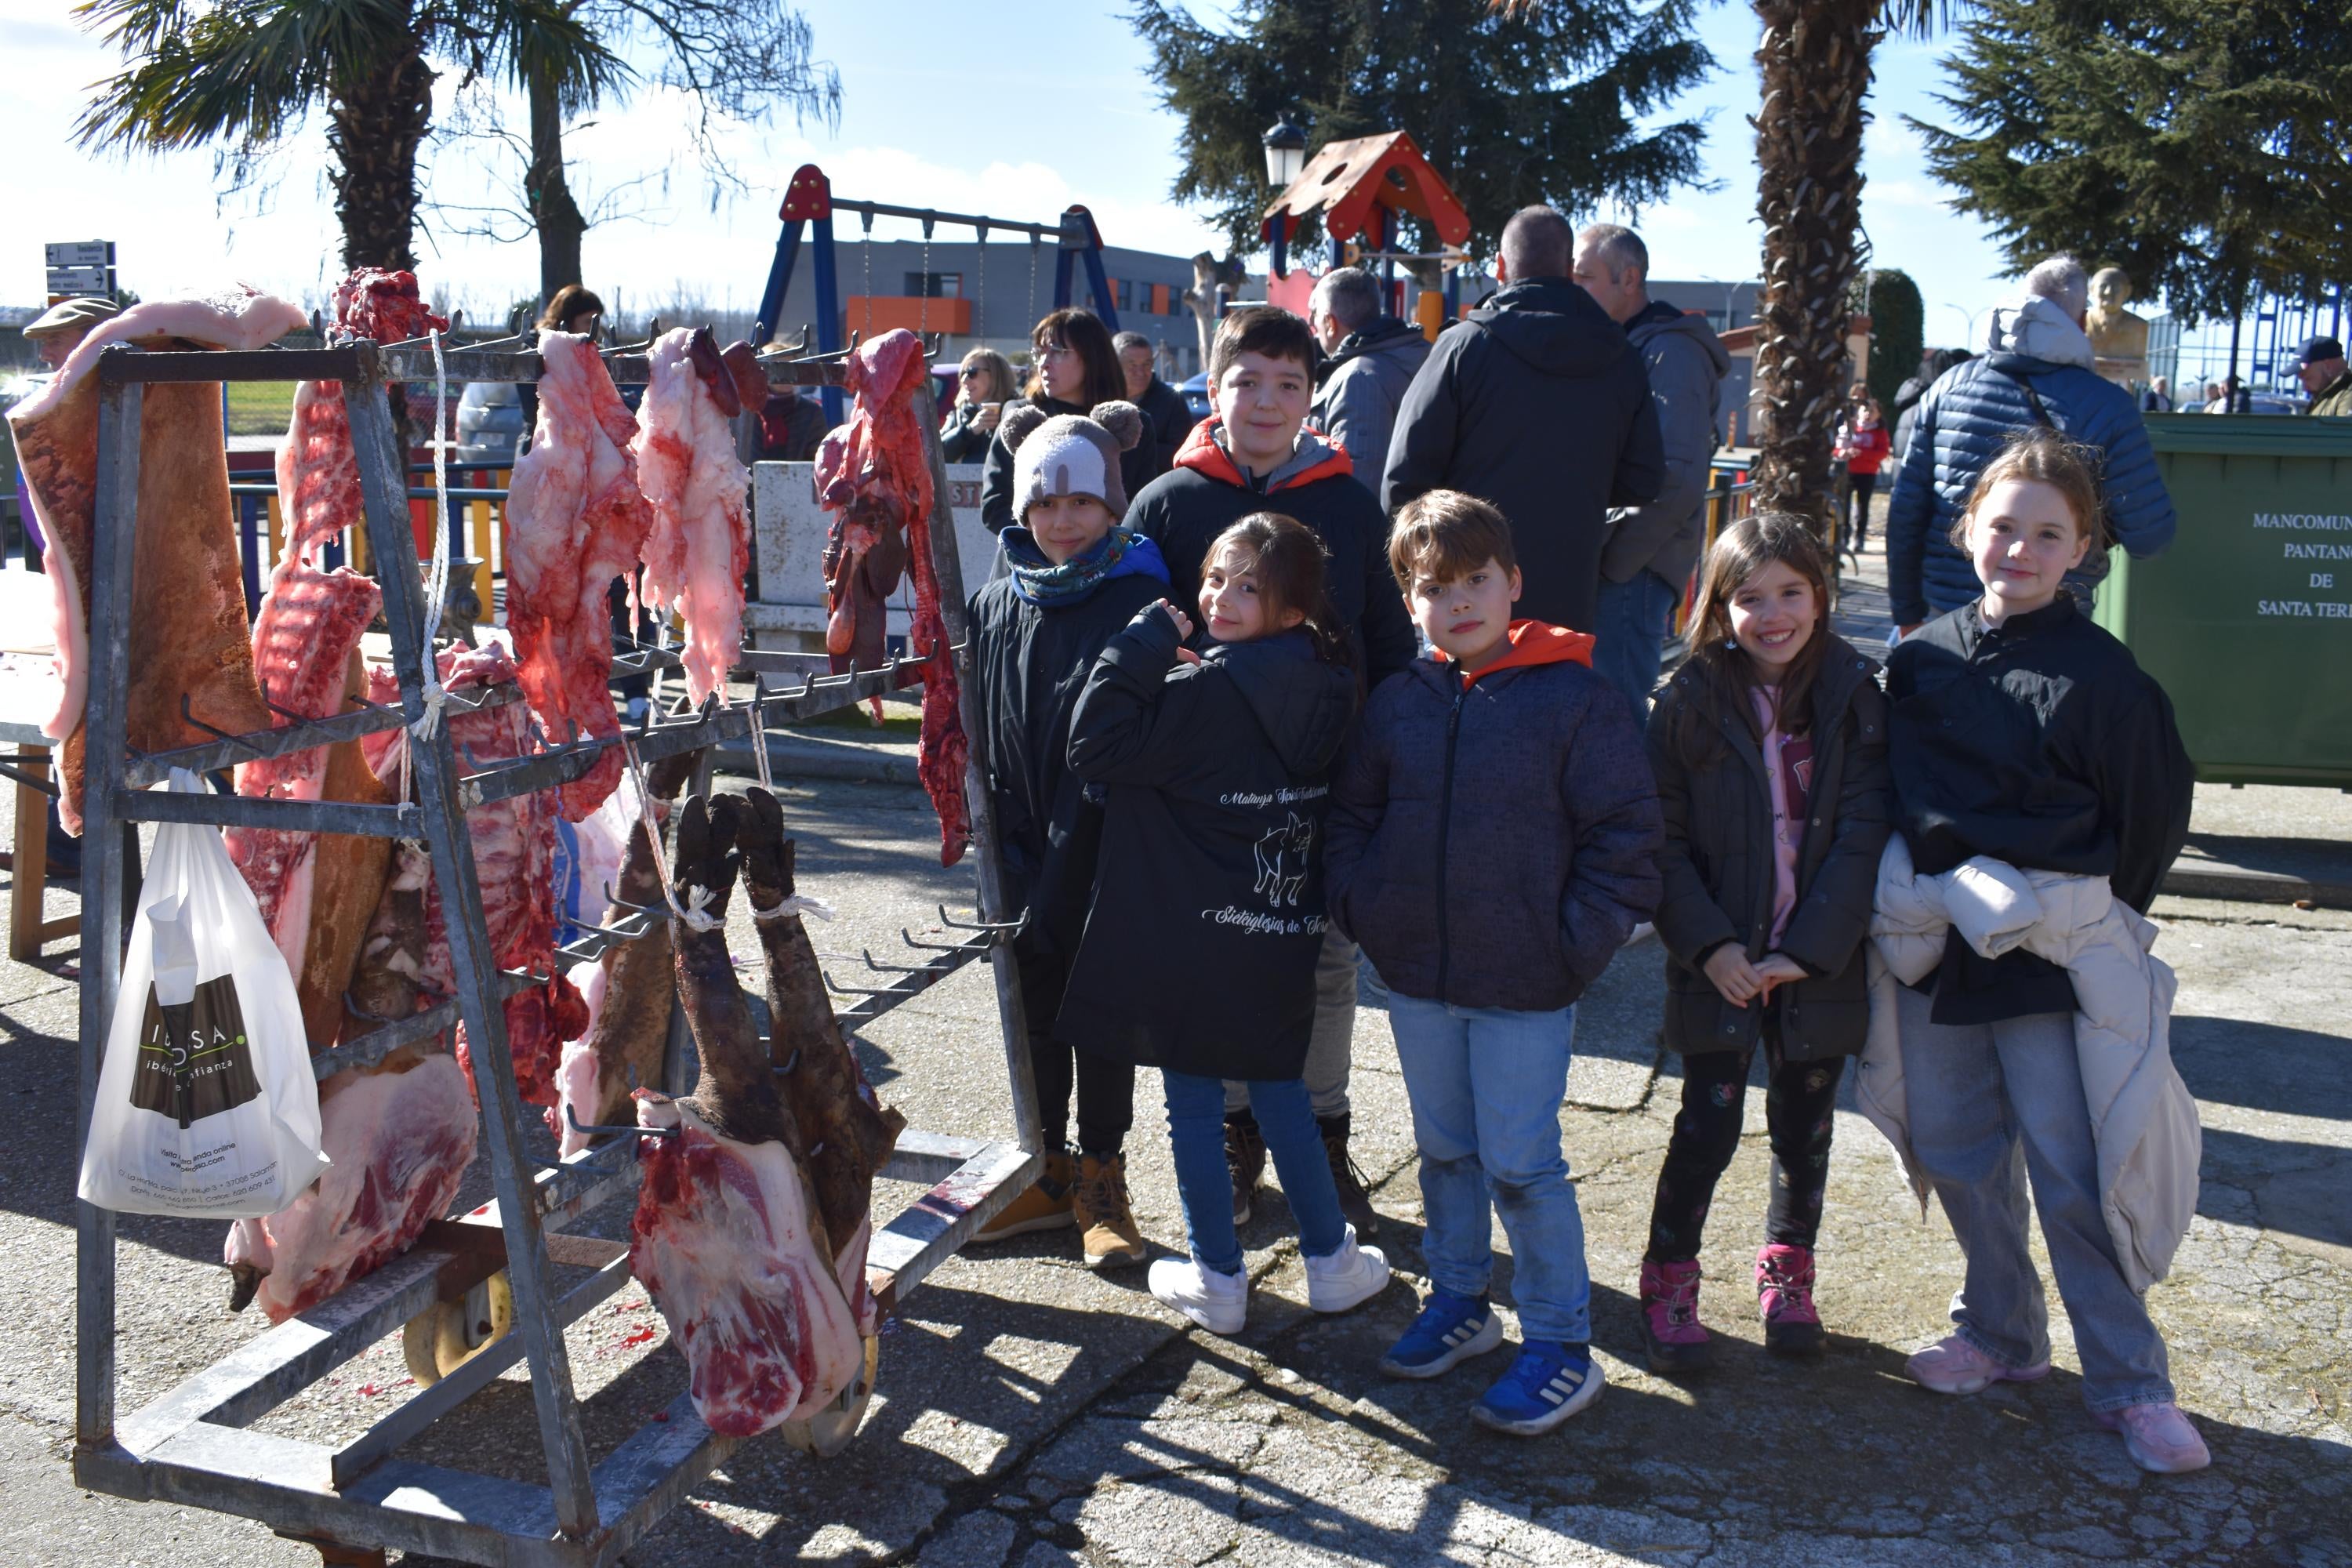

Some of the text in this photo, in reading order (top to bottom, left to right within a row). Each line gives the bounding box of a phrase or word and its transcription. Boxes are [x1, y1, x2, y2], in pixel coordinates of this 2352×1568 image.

[2283, 543, 2352, 559] PANTAN
[2309, 572, 2333, 588] DE
[2257, 600, 2312, 616] SANTA
[1220, 791, 1274, 810] Matanza
[1287, 920, 1301, 933] de
[212, 1142, 236, 1155] online
